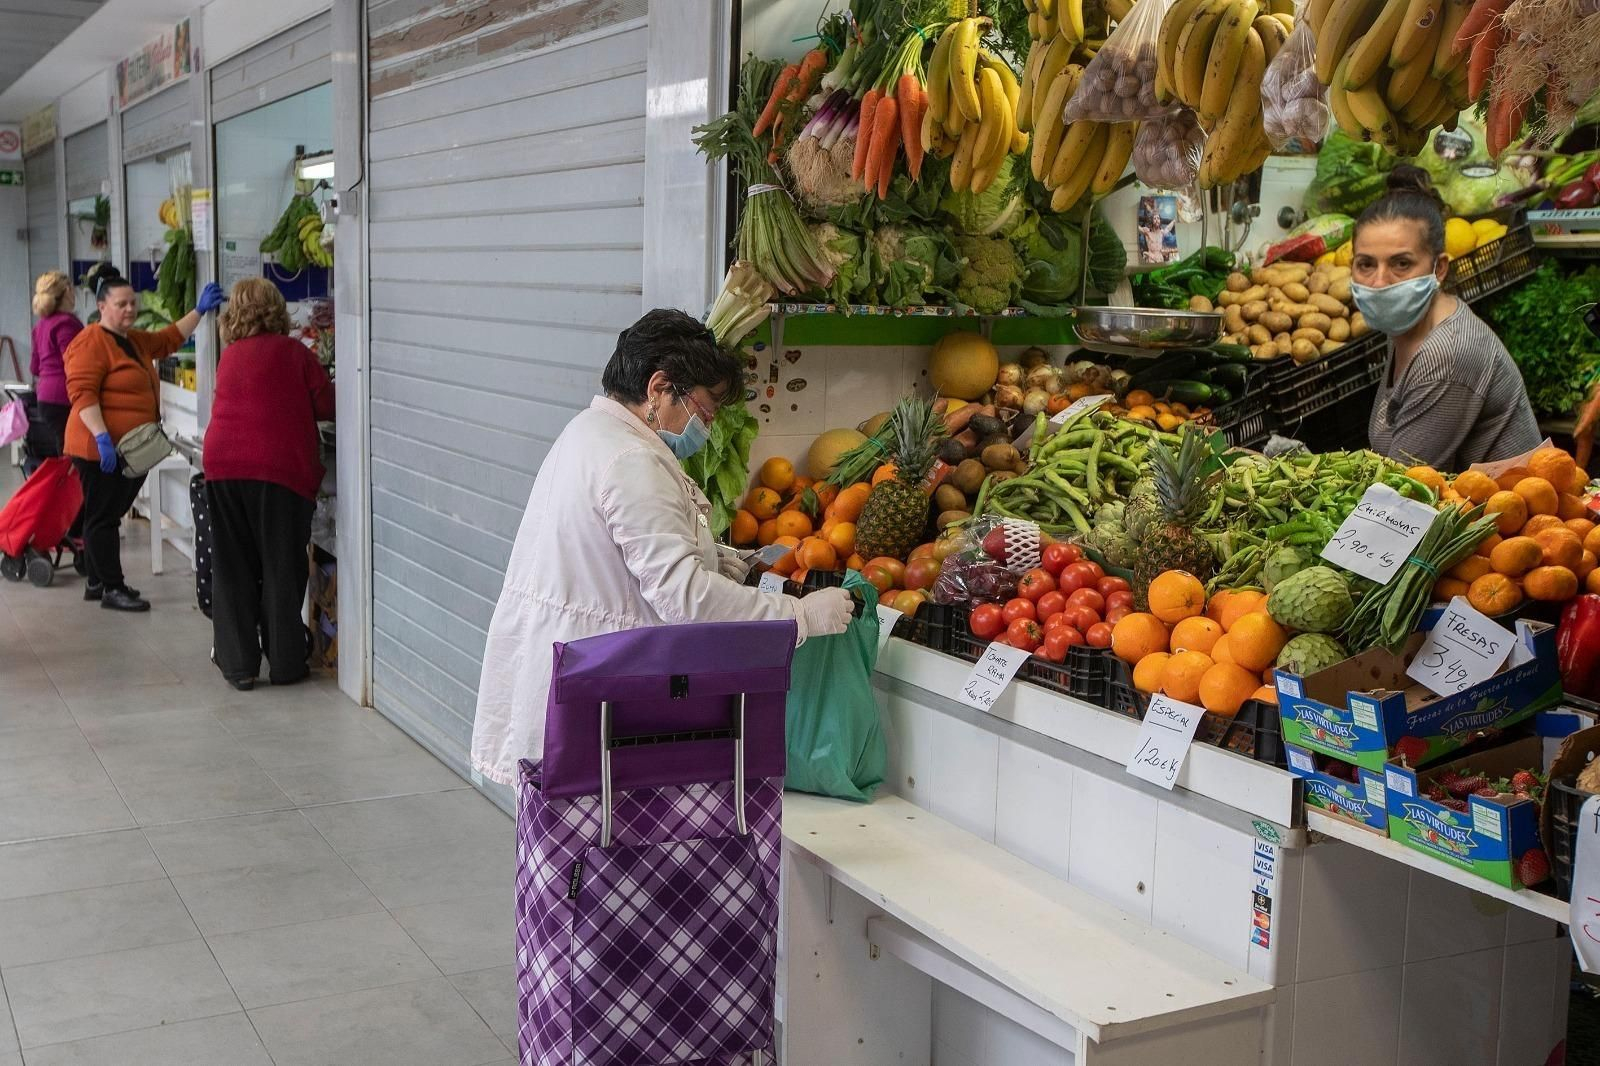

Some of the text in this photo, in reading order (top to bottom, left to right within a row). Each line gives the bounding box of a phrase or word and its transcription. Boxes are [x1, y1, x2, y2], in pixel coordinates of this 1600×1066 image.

[1447, 610, 1500, 655] FRESAS
[1406, 709, 1442, 730] Fresas
[1444, 701, 1455, 713] de
[1457, 697, 1467, 707] la
[1468, 683, 1501, 702] Huerta
[1503, 674, 1513, 687] de
[1300, 709, 1314, 721] LAS
[1313, 712, 1350, 737] VIRTUDES
[1449, 718, 1464, 734] LAS
[1464, 707, 1503, 727] VIRTUDES
[1314, 783, 1327, 795] LAS
[1326, 787, 1362, 813] VIRTUDES
[1411, 808, 1426, 822] LAS
[1425, 813, 1467, 843] VIRTUDES
[1257, 841, 1274, 855] VISA
[1256, 858, 1273, 873] VISA
[1260, 878, 1266, 886] V
